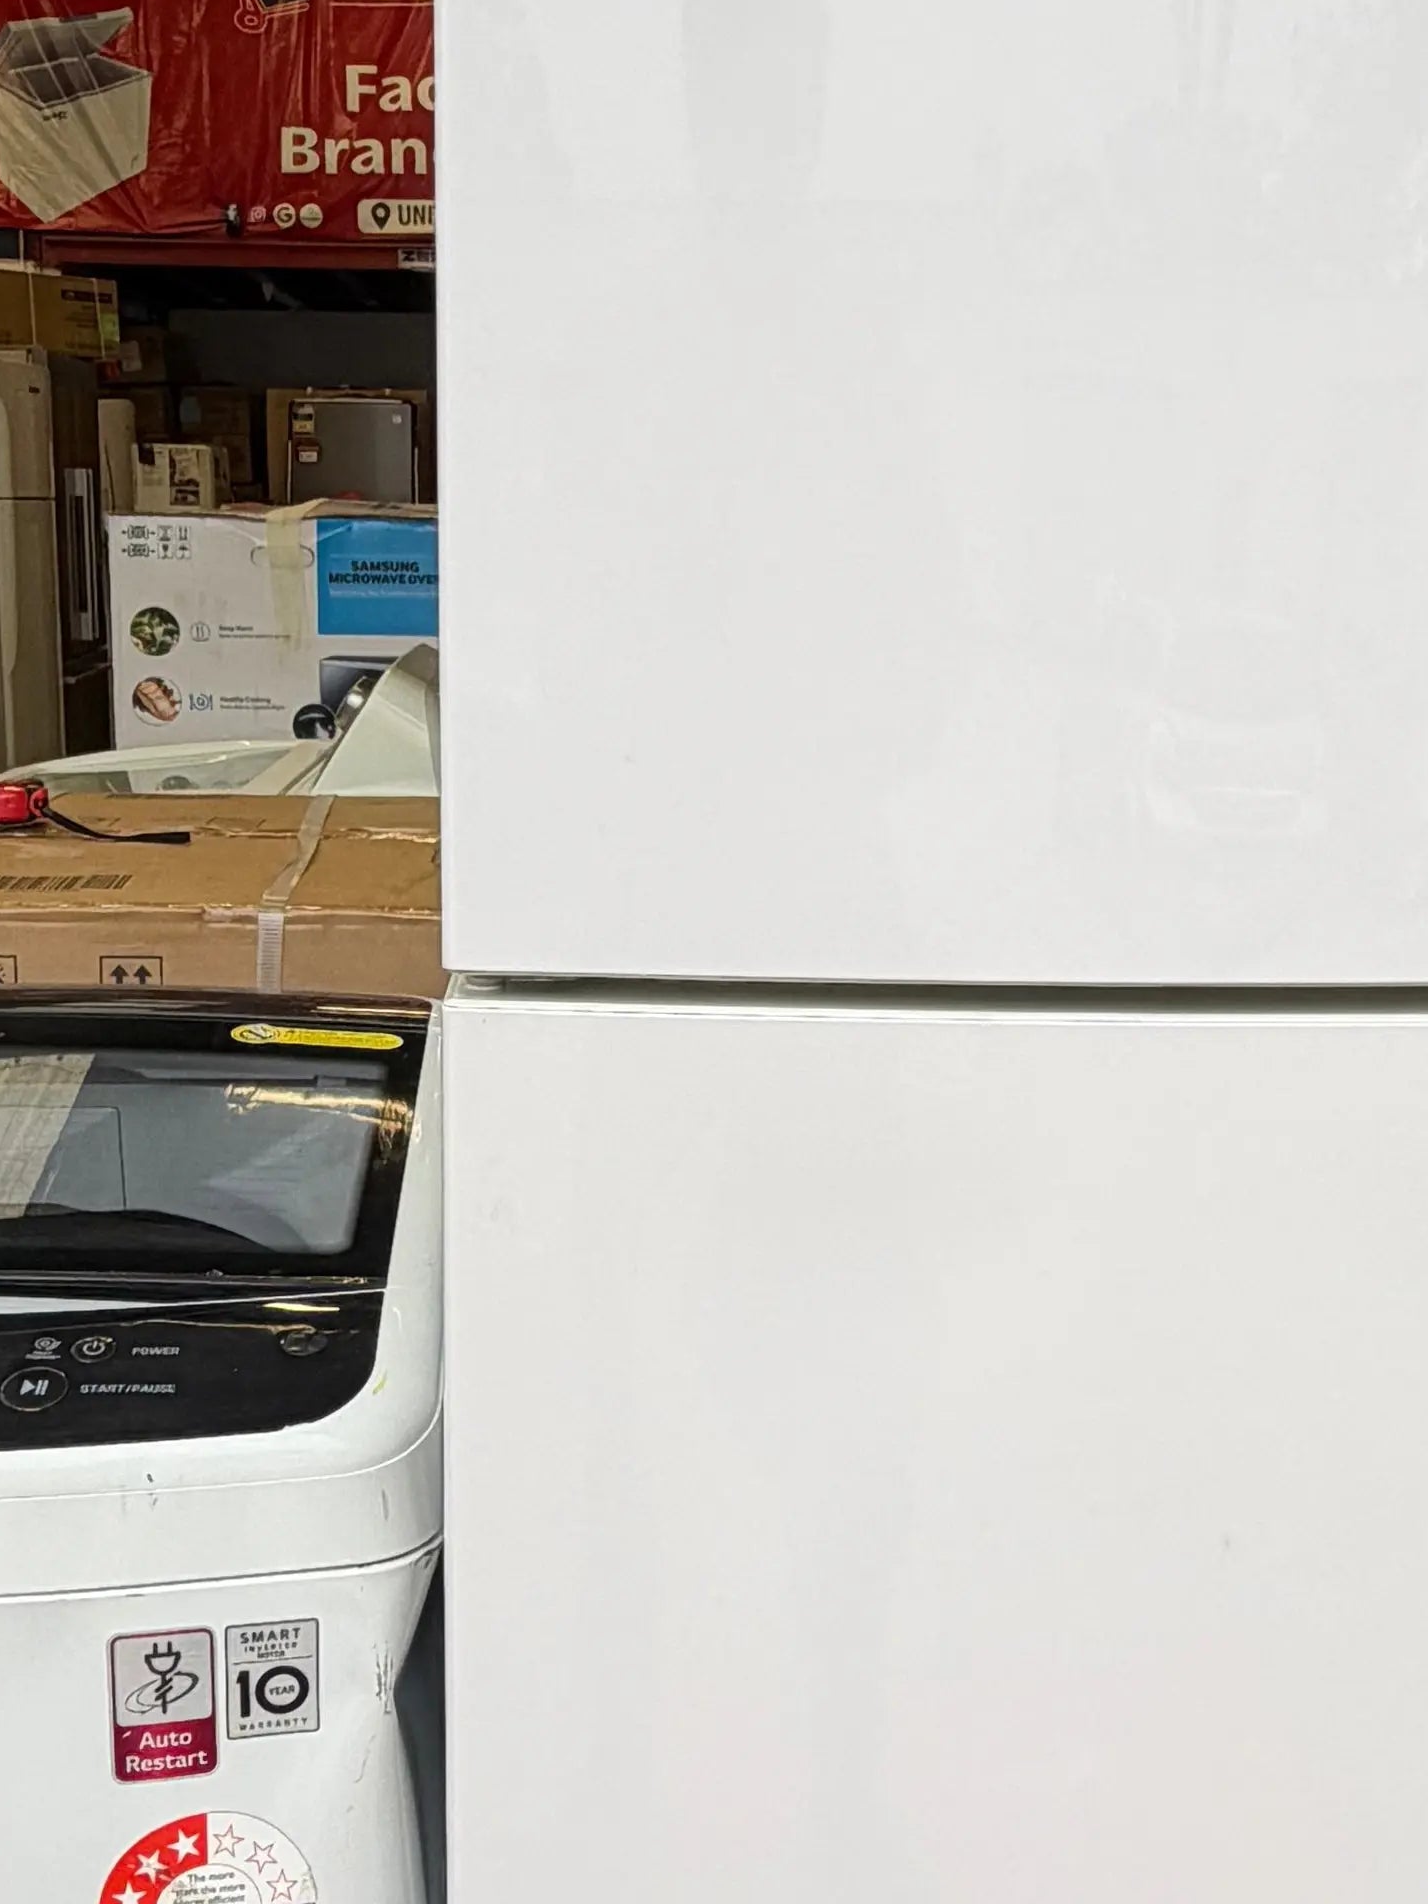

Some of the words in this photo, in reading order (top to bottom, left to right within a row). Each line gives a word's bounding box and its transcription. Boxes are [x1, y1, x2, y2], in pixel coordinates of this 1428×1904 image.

[281, 126, 429, 176] Bran
[350, 560, 420, 573] SAMSUNG
[329, 573, 406, 585] MICROWAVE
[131, 1346, 180, 1356] POWER
[80, 1383, 176, 1394] START/PAUSE
[239, 1627, 301, 1645] SMART
[236, 1665, 310, 1718] 10
[269, 1684, 295, 1696] YEAR
[239, 1717, 308, 1731] WARRANTY
[138, 1730, 193, 1750] Auto
[125, 1749, 209, 1774] Restart
